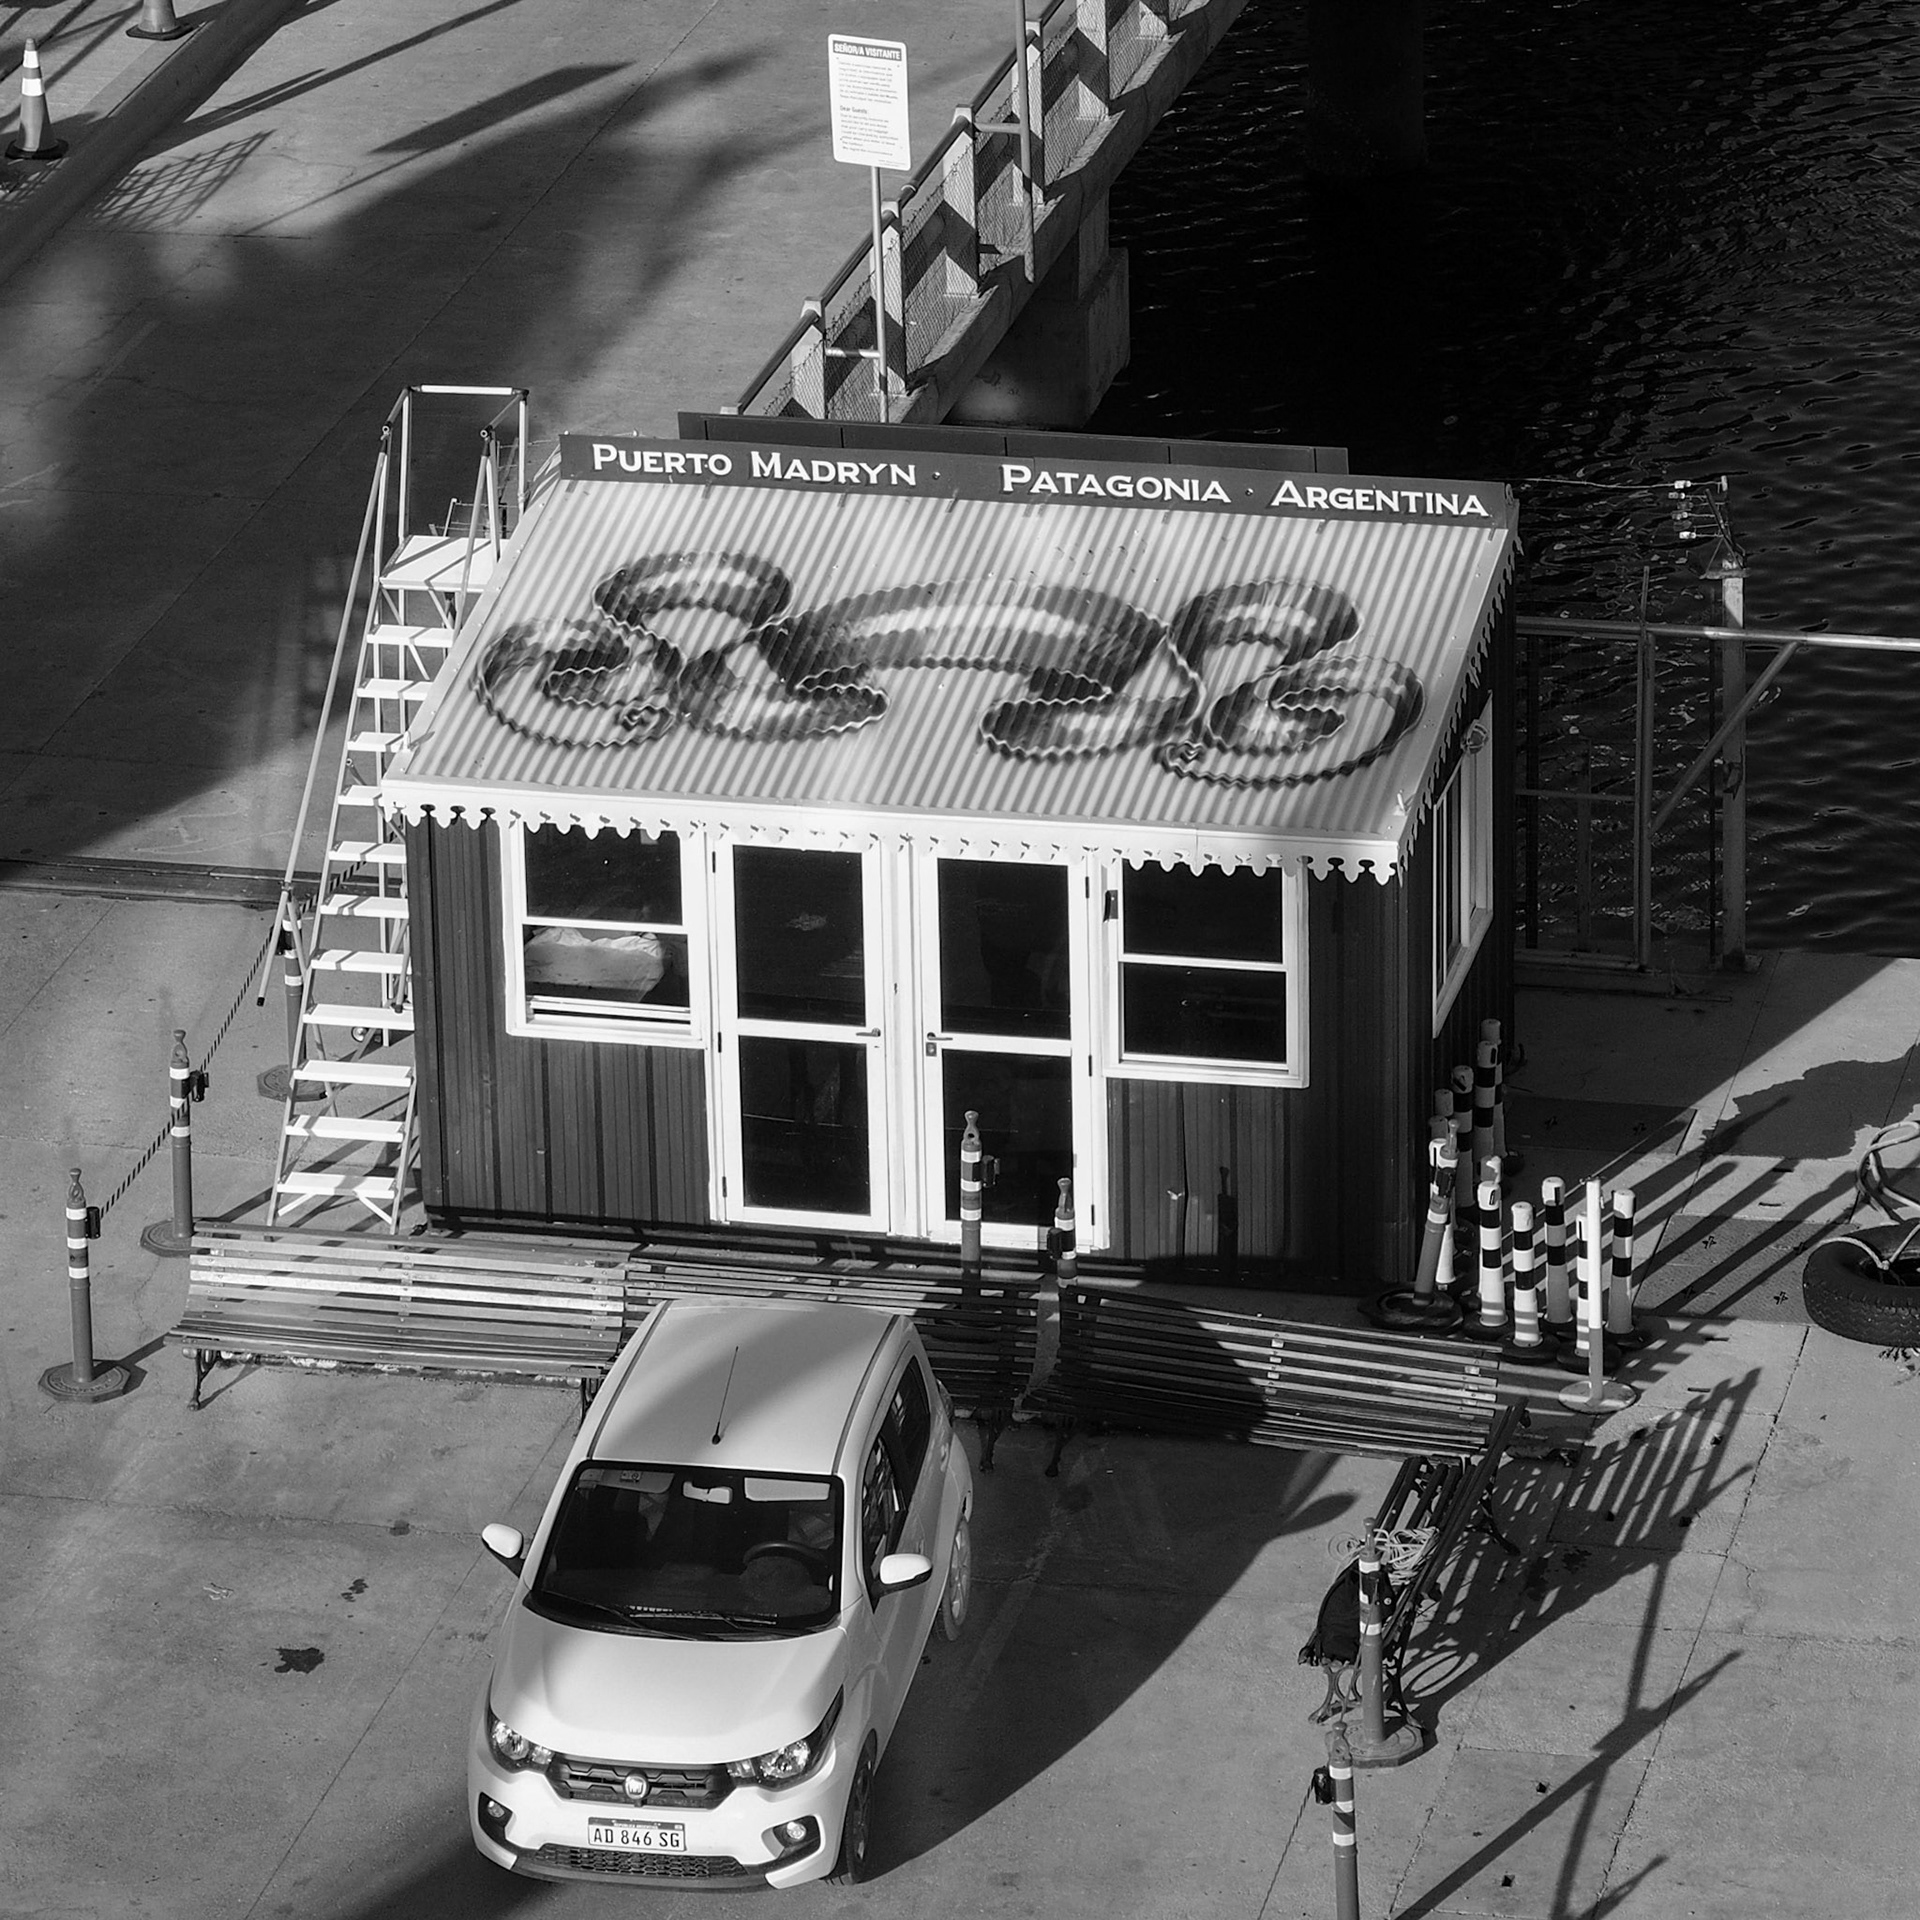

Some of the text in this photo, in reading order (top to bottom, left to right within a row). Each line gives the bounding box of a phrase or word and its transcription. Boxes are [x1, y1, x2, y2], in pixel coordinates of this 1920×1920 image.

[834, 43, 901, 60] SEÑOR/A VISITANTE
[592, 443, 1490, 518] PUERTO MADRYN PATAGONIA ARGENTINA
[594, 1828, 680, 1847] AD 846 SG
